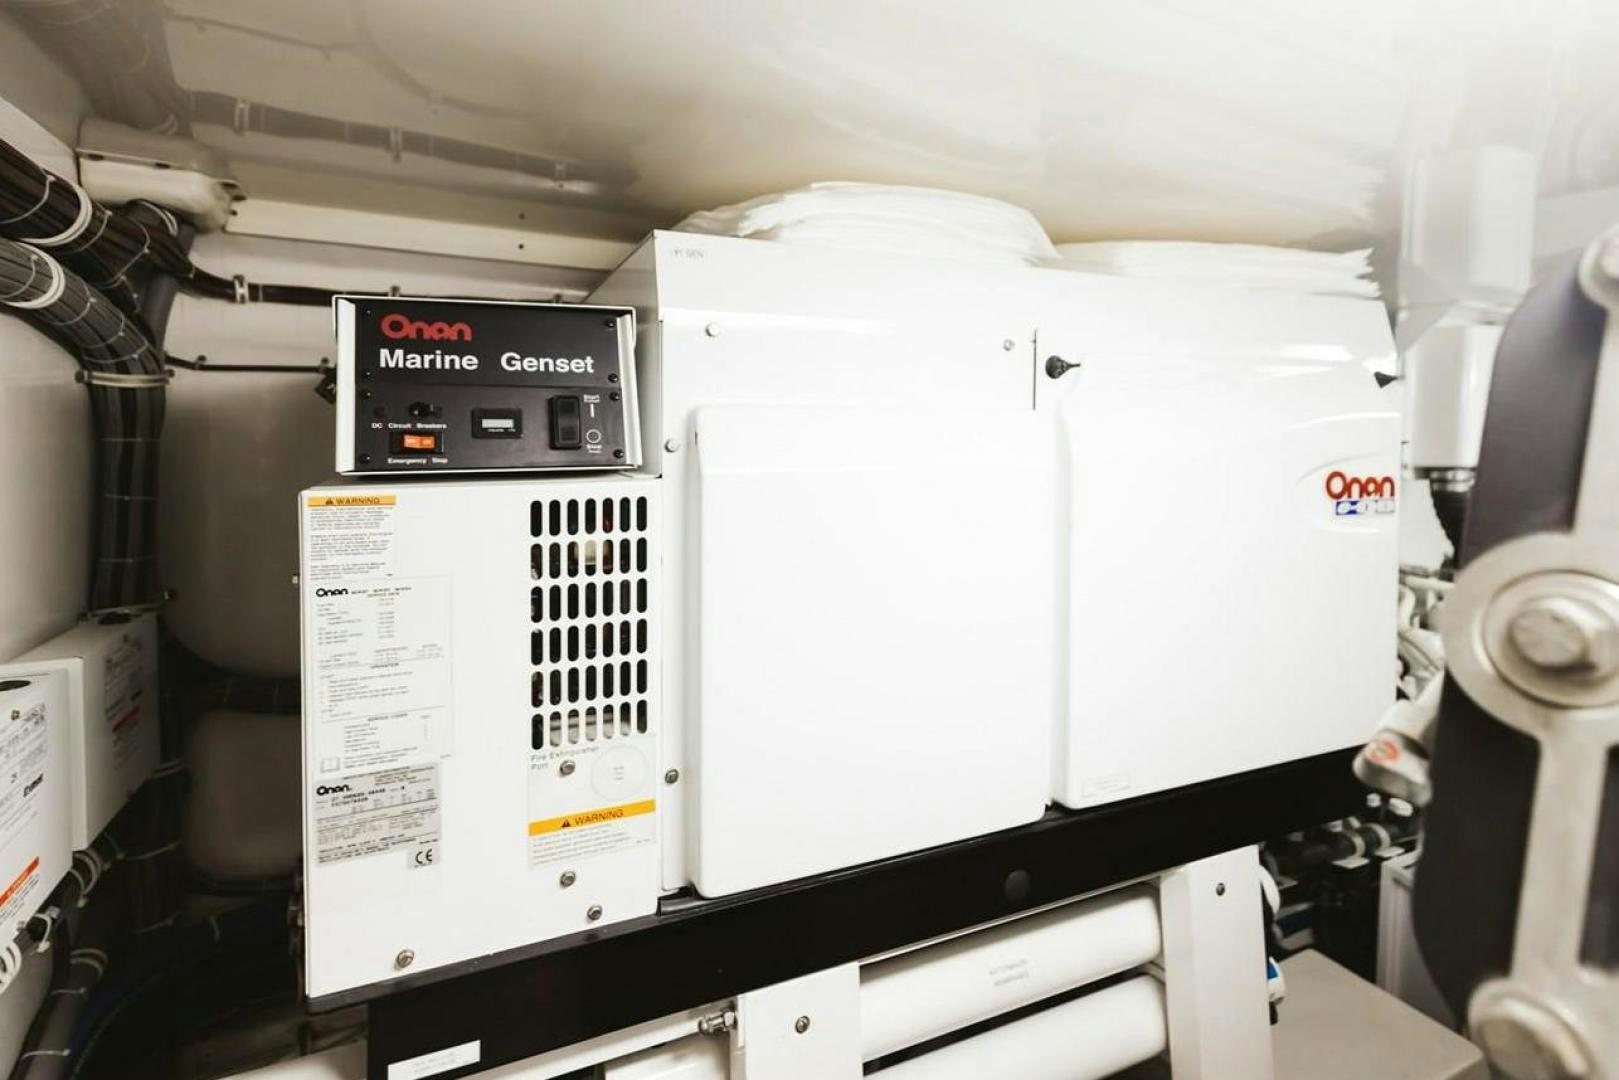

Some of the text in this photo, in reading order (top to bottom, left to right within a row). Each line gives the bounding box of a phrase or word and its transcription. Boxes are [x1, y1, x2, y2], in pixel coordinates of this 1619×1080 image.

[380, 313, 473, 342] Onan
[379, 348, 595, 374] Marine Genset
[387, 457, 428, 465] Emergency
[1326, 471, 1395, 500] Onan
[335, 497, 380, 505] WARNING
[315, 588, 349, 597] Onan
[574, 808, 624, 826] WARNING
